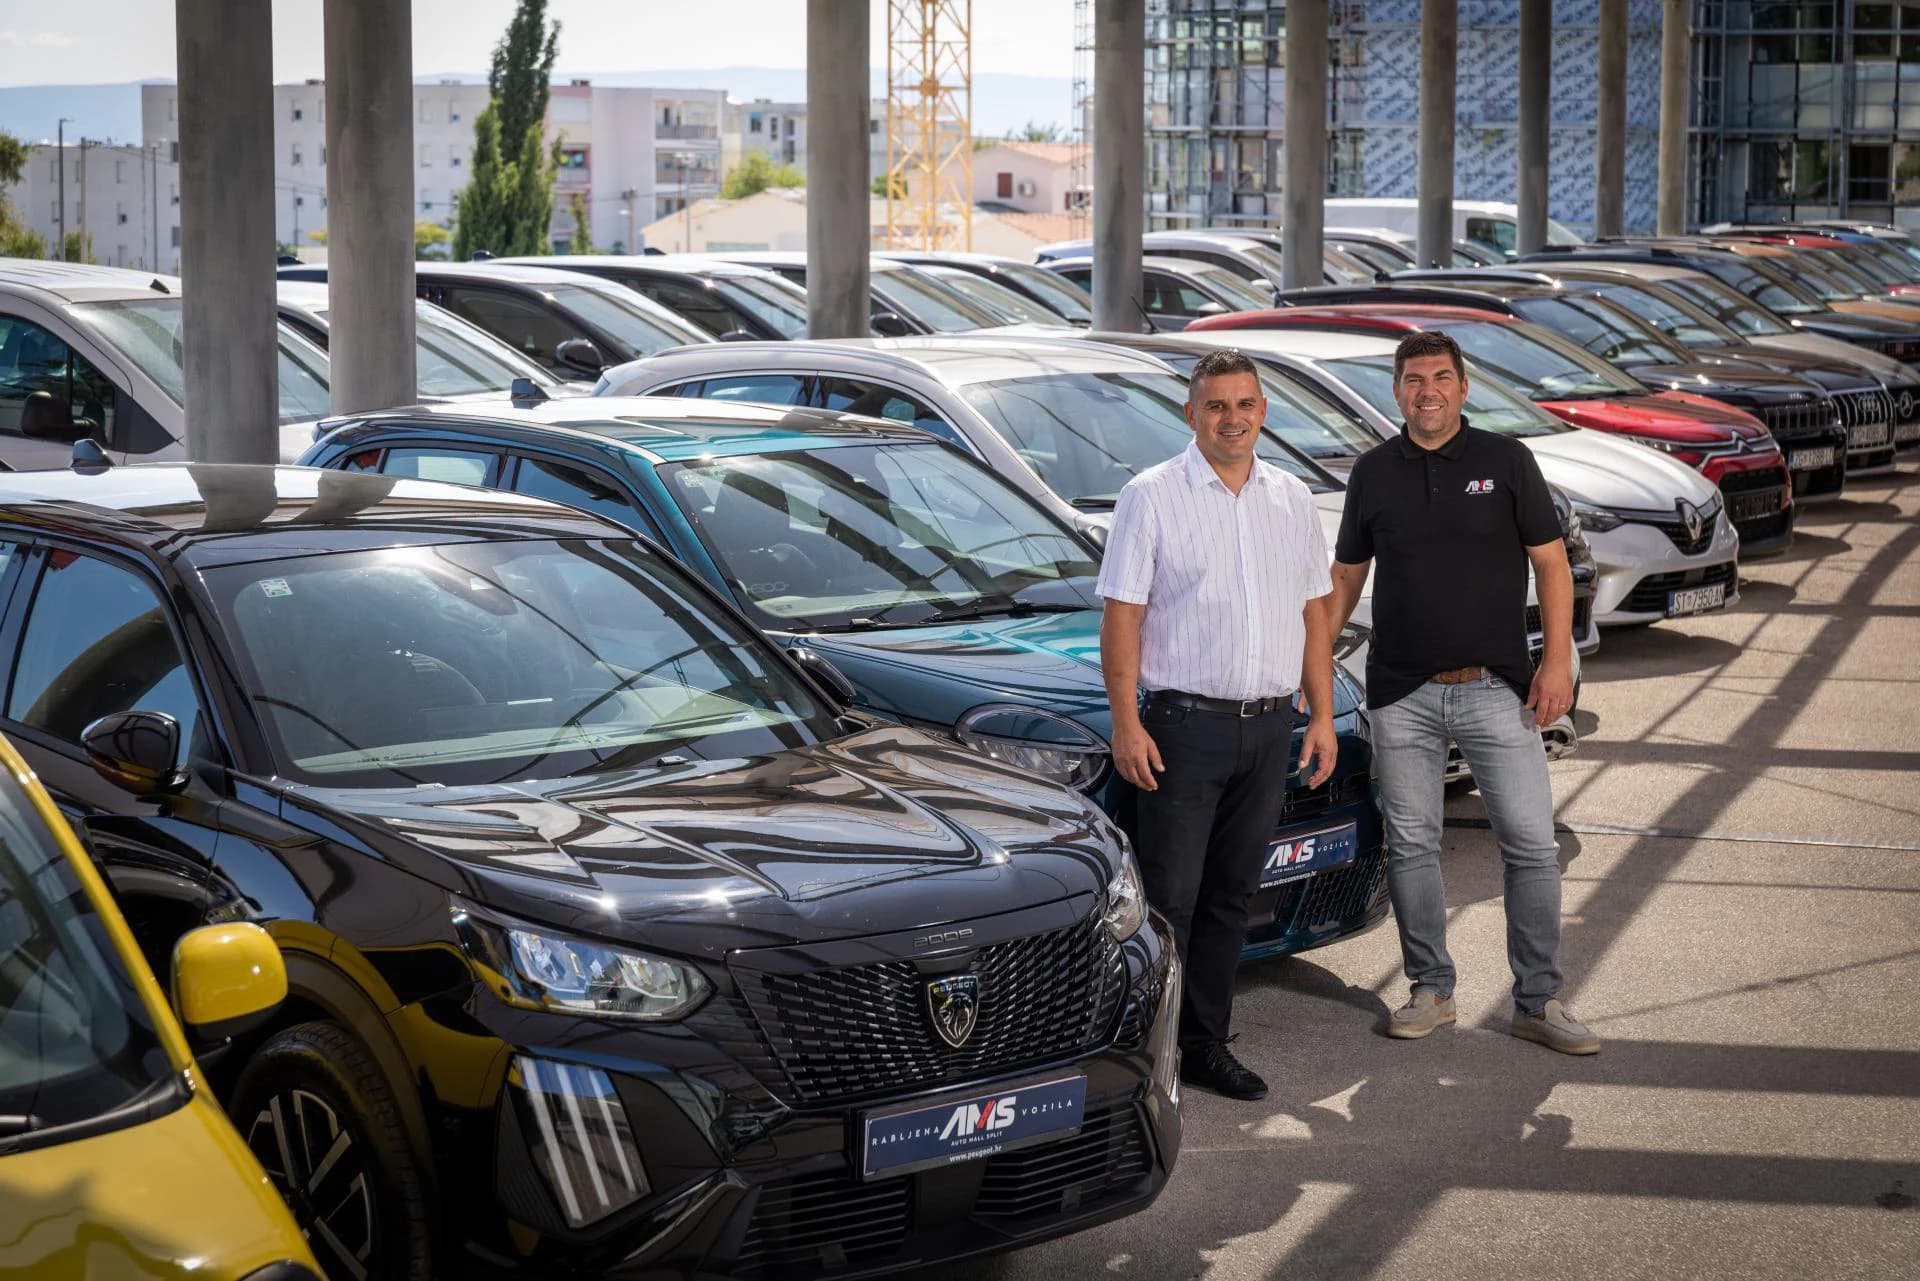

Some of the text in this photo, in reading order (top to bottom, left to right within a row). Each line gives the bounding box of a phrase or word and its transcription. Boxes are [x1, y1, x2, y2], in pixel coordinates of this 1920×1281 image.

[1464, 479, 1495, 492] AMS
[1675, 592, 1686, 612] ST
[1264, 838, 1350, 870] AMS VOZILA
[913, 928, 973, 947] 2008
[933, 981, 974, 994] PEUGEOT
[872, 1096, 1073, 1147] RABLJENA AMS VOZILA
[950, 1131, 1003, 1147] AUTO MALL SPLIT
[949, 1145, 1003, 1163] www.peugeot.hr
